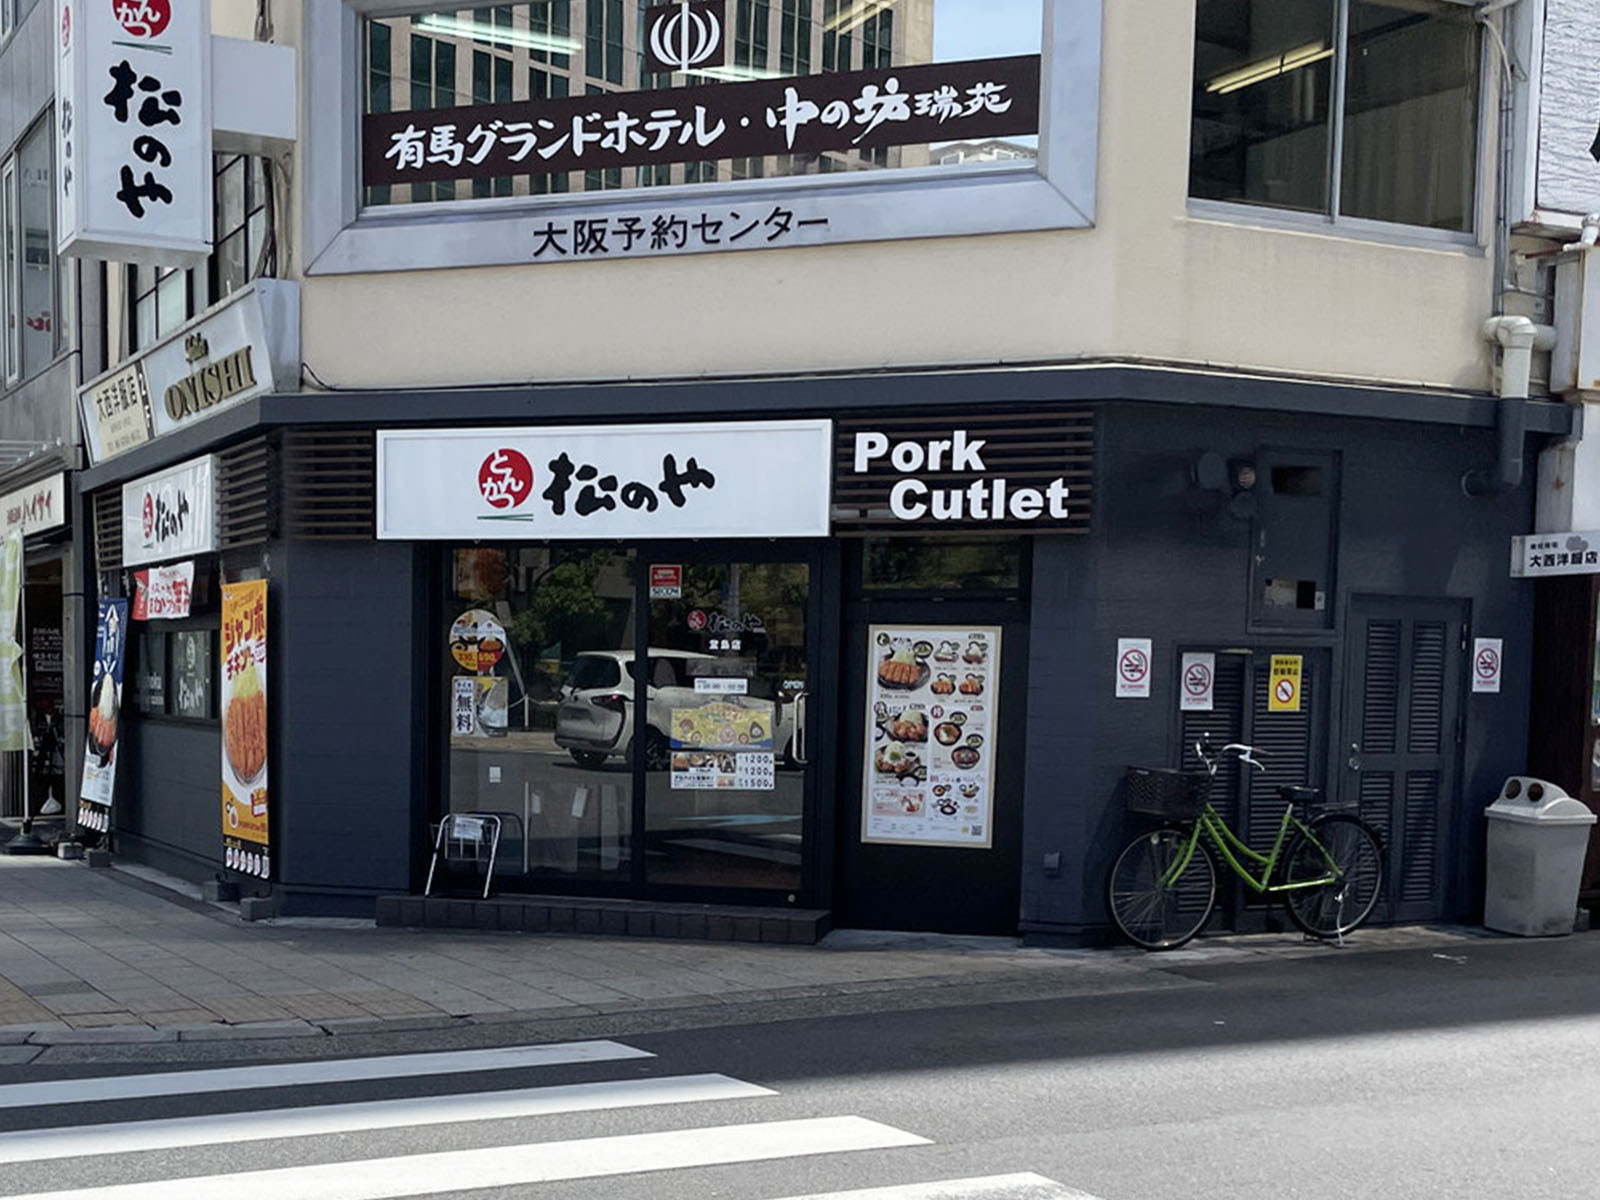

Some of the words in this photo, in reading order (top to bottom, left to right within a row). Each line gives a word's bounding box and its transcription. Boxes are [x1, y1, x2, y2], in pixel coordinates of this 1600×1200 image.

[104, 60, 182, 218] 松のや
[532, 205, 830, 258] 大阪予約センター
[164, 345, 258, 422] ONISHI
[480, 449, 532, 509] とんかつ
[854, 431, 986, 472] Pork
[543, 453, 716, 516] 松のや
[890, 478, 1069, 520] Cutlet
[1529, 551, 1598, 568] 大西洋服店
